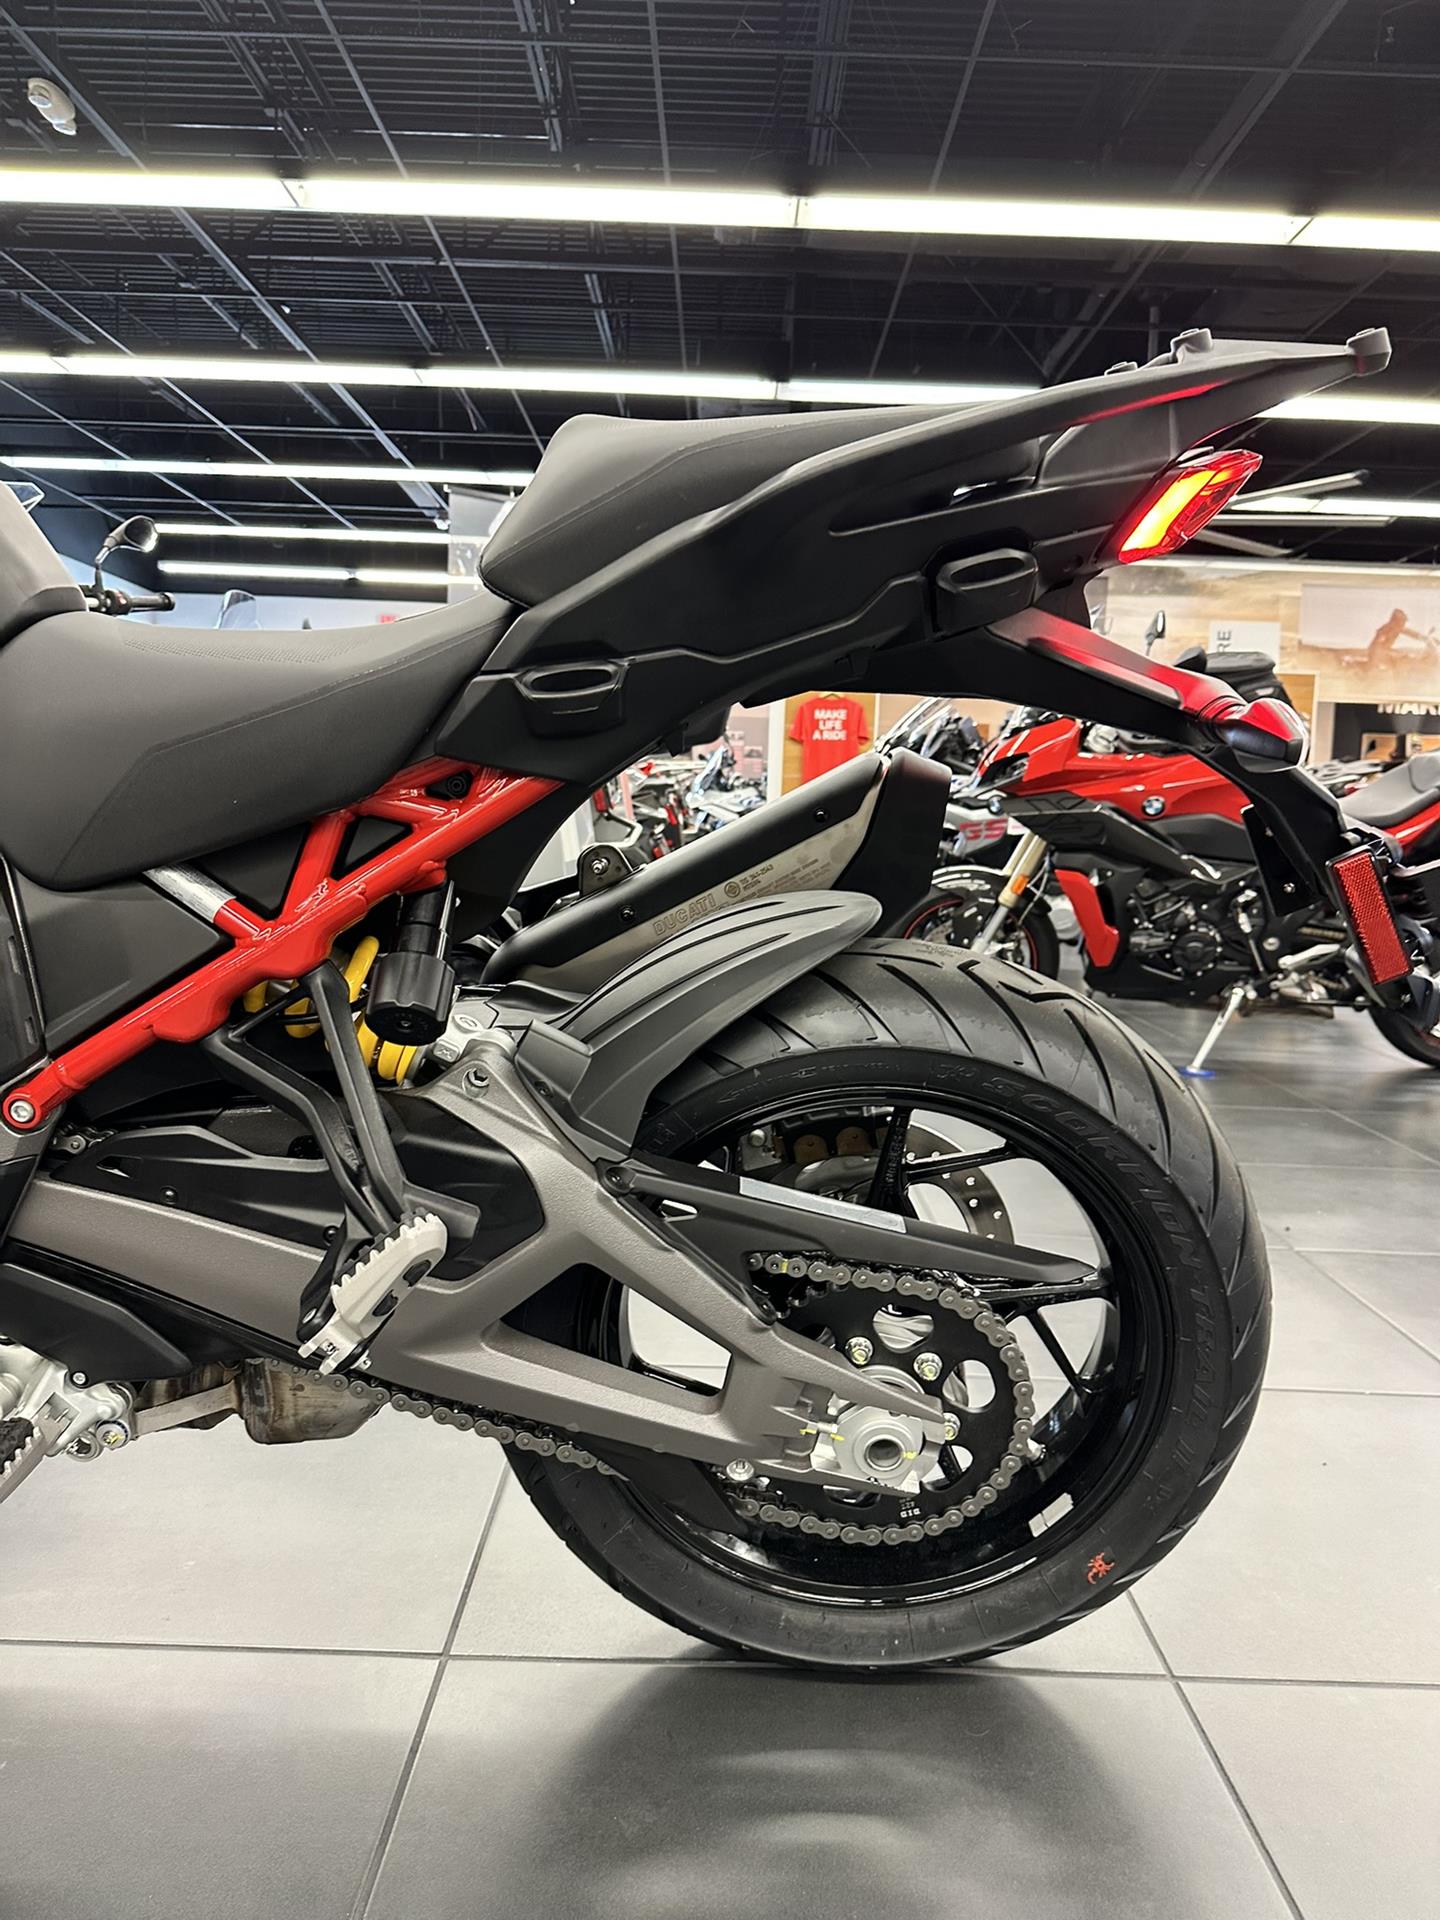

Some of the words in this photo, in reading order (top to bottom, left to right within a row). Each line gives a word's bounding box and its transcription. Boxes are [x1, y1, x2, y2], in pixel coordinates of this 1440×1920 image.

[814, 709, 847, 720] MAKE
[819, 720, 843, 730] LIFE
[812, 730, 822, 740] A
[822, 730, 847, 740] RIDE
[653, 893, 717, 936] DUCATI
[981, 1070, 1205, 1269] SCORPION
